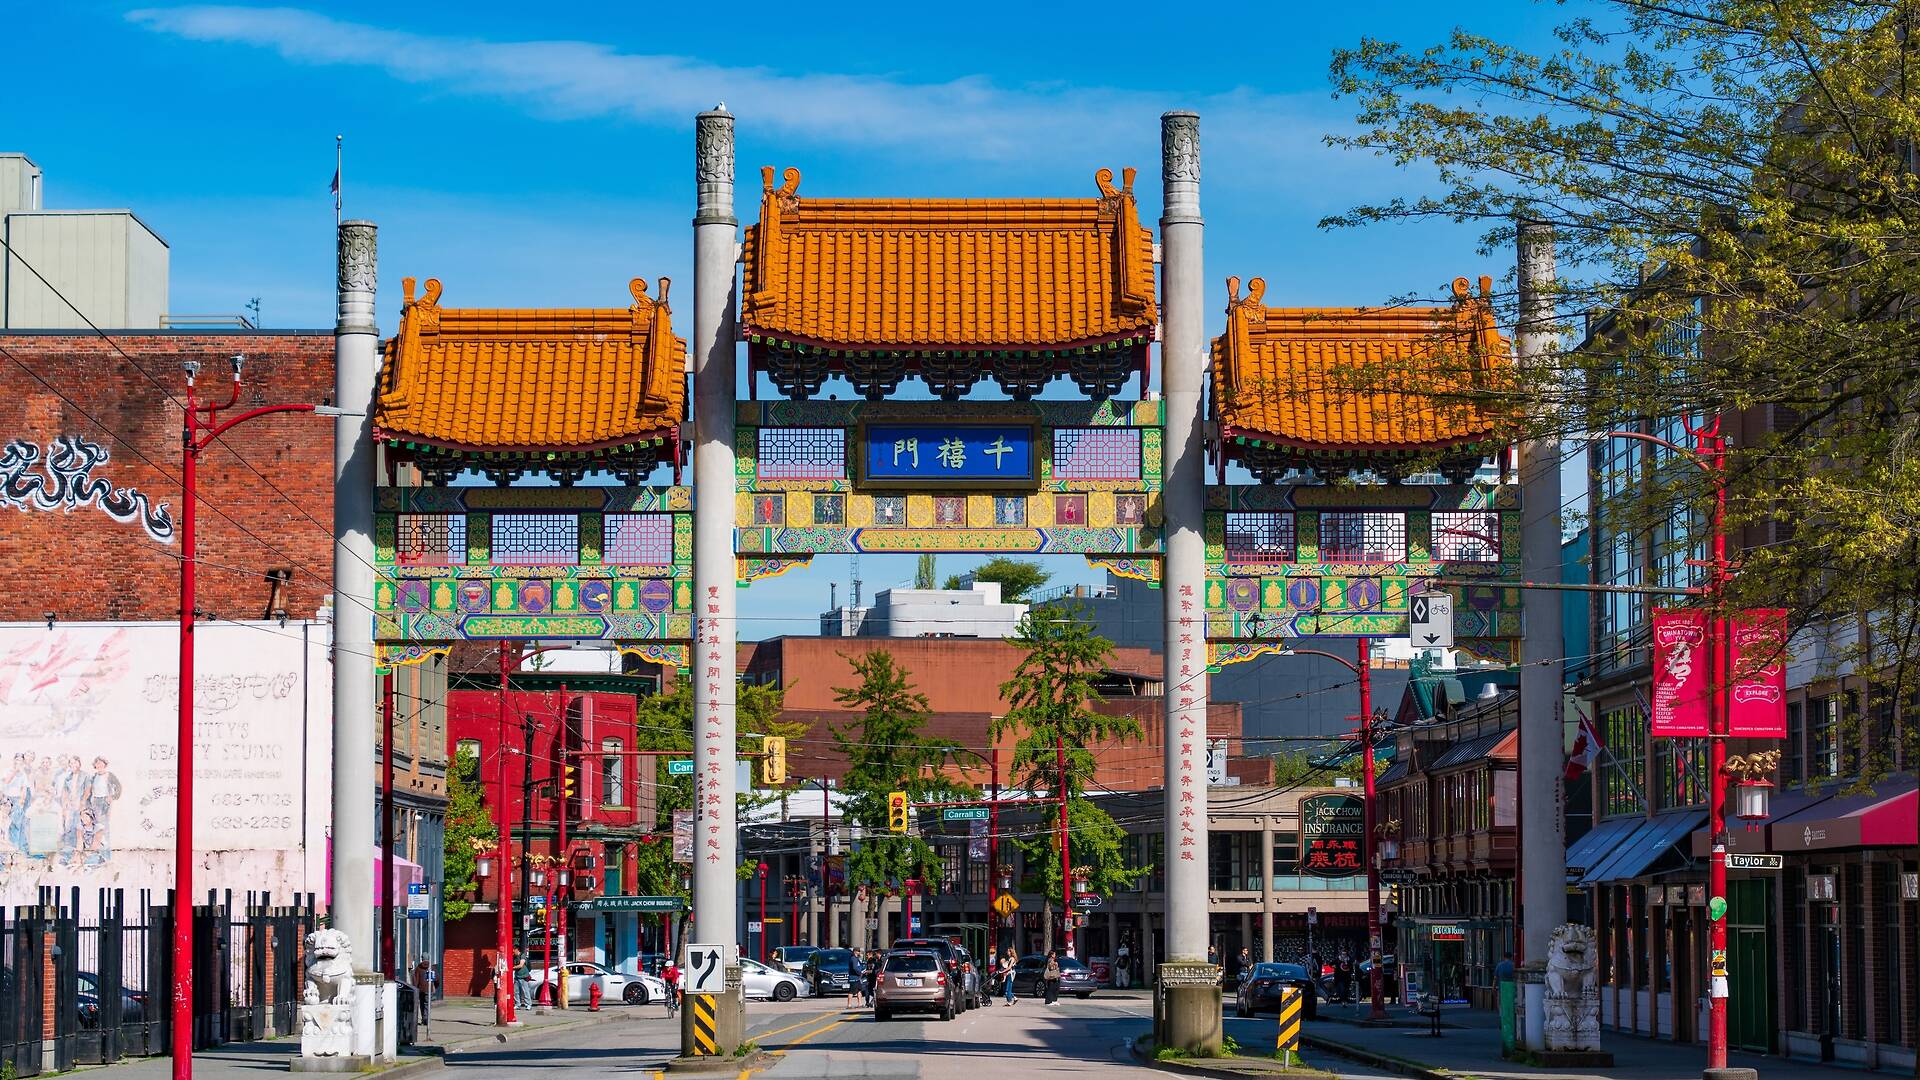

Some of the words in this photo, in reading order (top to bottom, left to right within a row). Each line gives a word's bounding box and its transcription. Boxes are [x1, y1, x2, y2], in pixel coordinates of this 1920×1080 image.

[1662, 629, 1698, 638] CHINATOWN
[149, 743, 210, 761] BEATY
[948, 810, 974, 819] Carrall
[976, 810, 985, 818] St
[1315, 807, 1336, 817] JACK
[1336, 807, 1361, 816] CHOW
[1304, 823, 1364, 834] INSURANCE
[1734, 856, 1764, 867] Taylor
